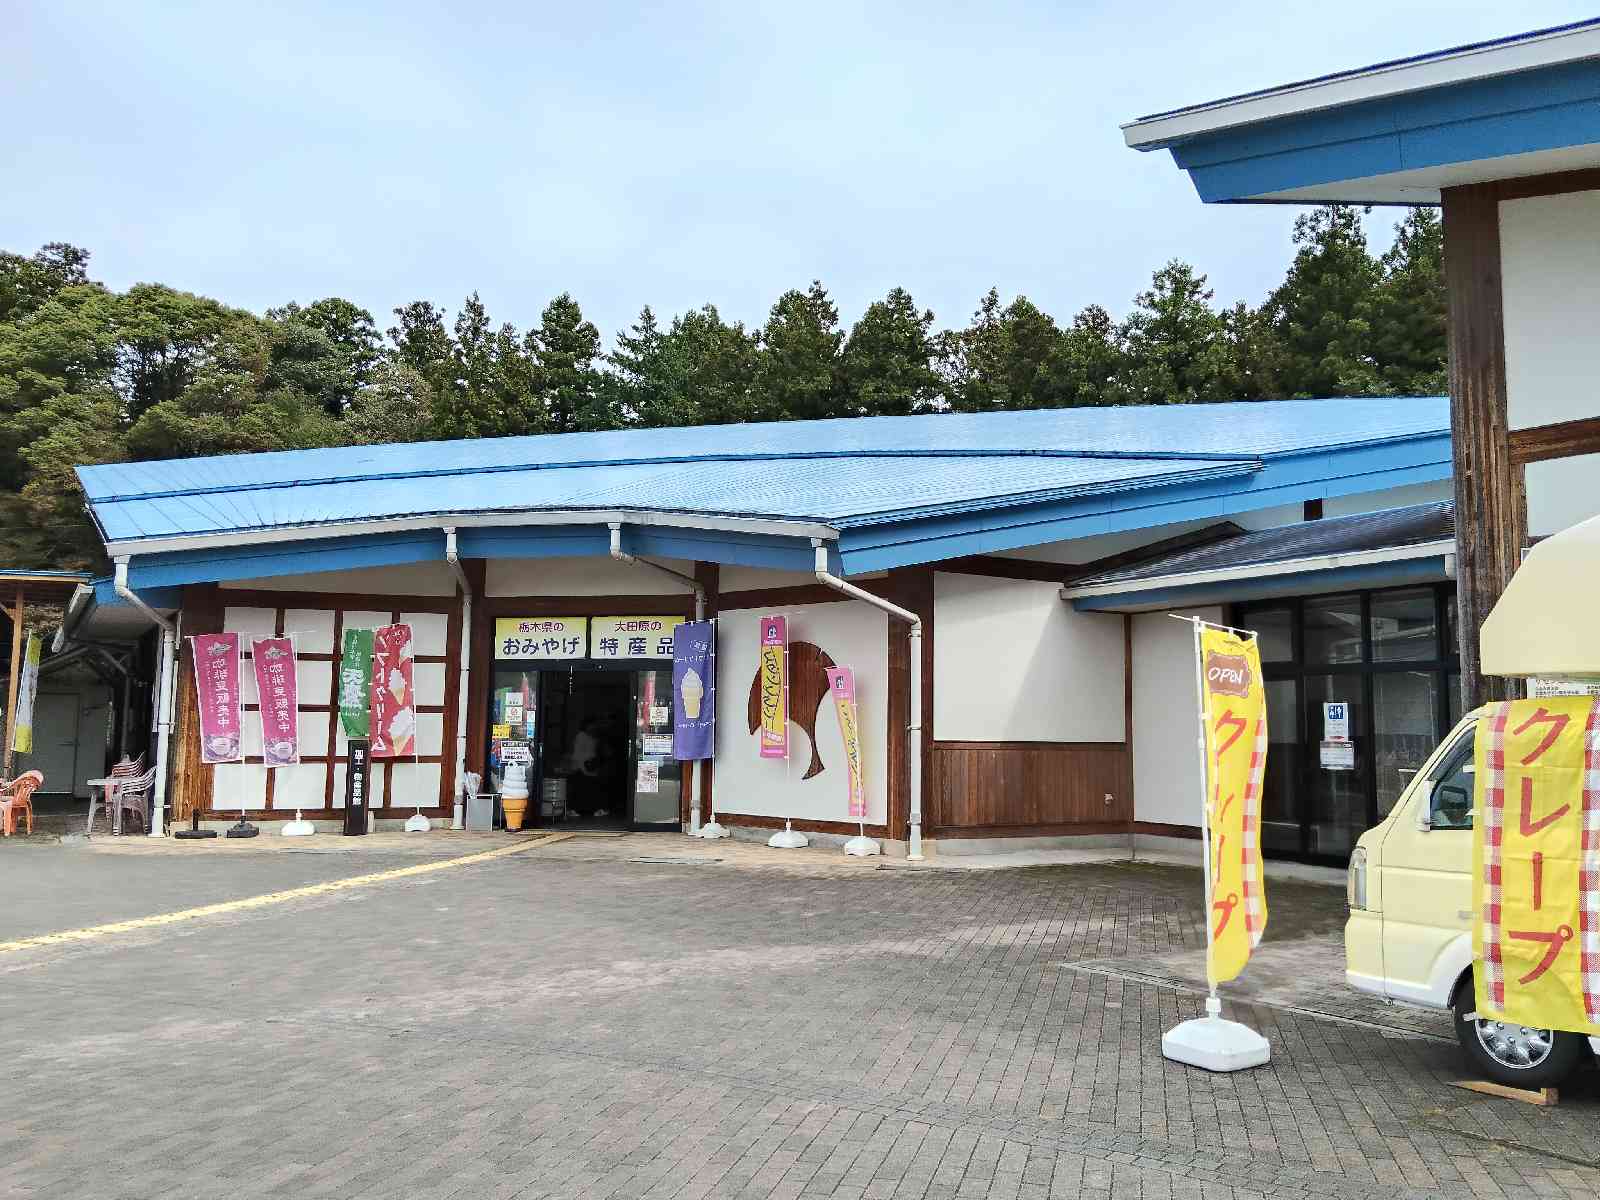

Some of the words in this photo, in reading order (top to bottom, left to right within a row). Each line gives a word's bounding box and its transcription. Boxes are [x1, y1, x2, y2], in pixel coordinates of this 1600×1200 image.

[518, 621, 564, 632] 栃木県の
[614, 620, 662, 632] 大田原の
[502, 636, 580, 655] おみやげ
[599, 636, 674, 656] 特産品
[1208, 667, 1244, 684] OPEN
[1508, 708, 1574, 985] クレープ
